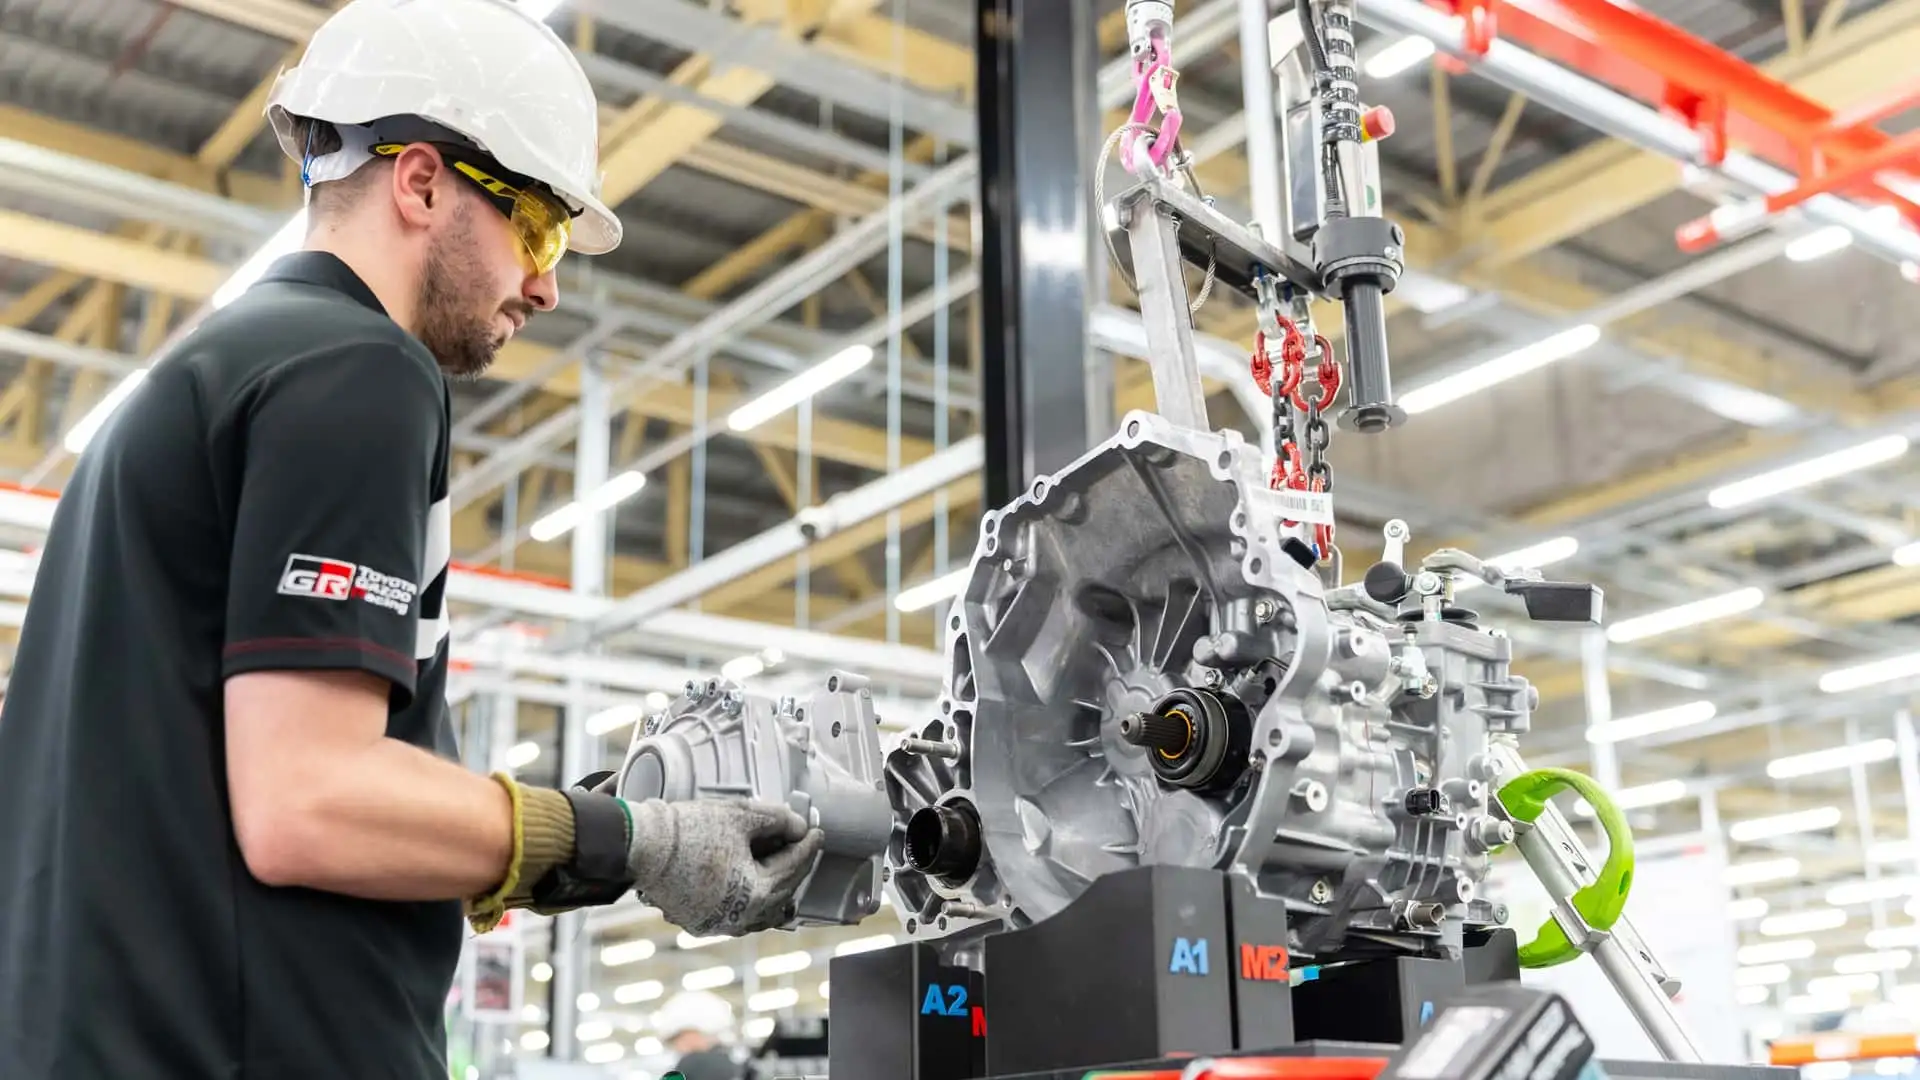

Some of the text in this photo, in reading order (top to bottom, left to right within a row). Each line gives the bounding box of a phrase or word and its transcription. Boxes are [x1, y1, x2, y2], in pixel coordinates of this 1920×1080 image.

[284, 569, 348, 597] GR
[355, 576, 412, 603] GAZOO
[358, 564, 417, 595] TOYOTA
[1169, 937, 1208, 975] A1
[1240, 943, 1290, 981] M2
[921, 984, 968, 1016] A2
